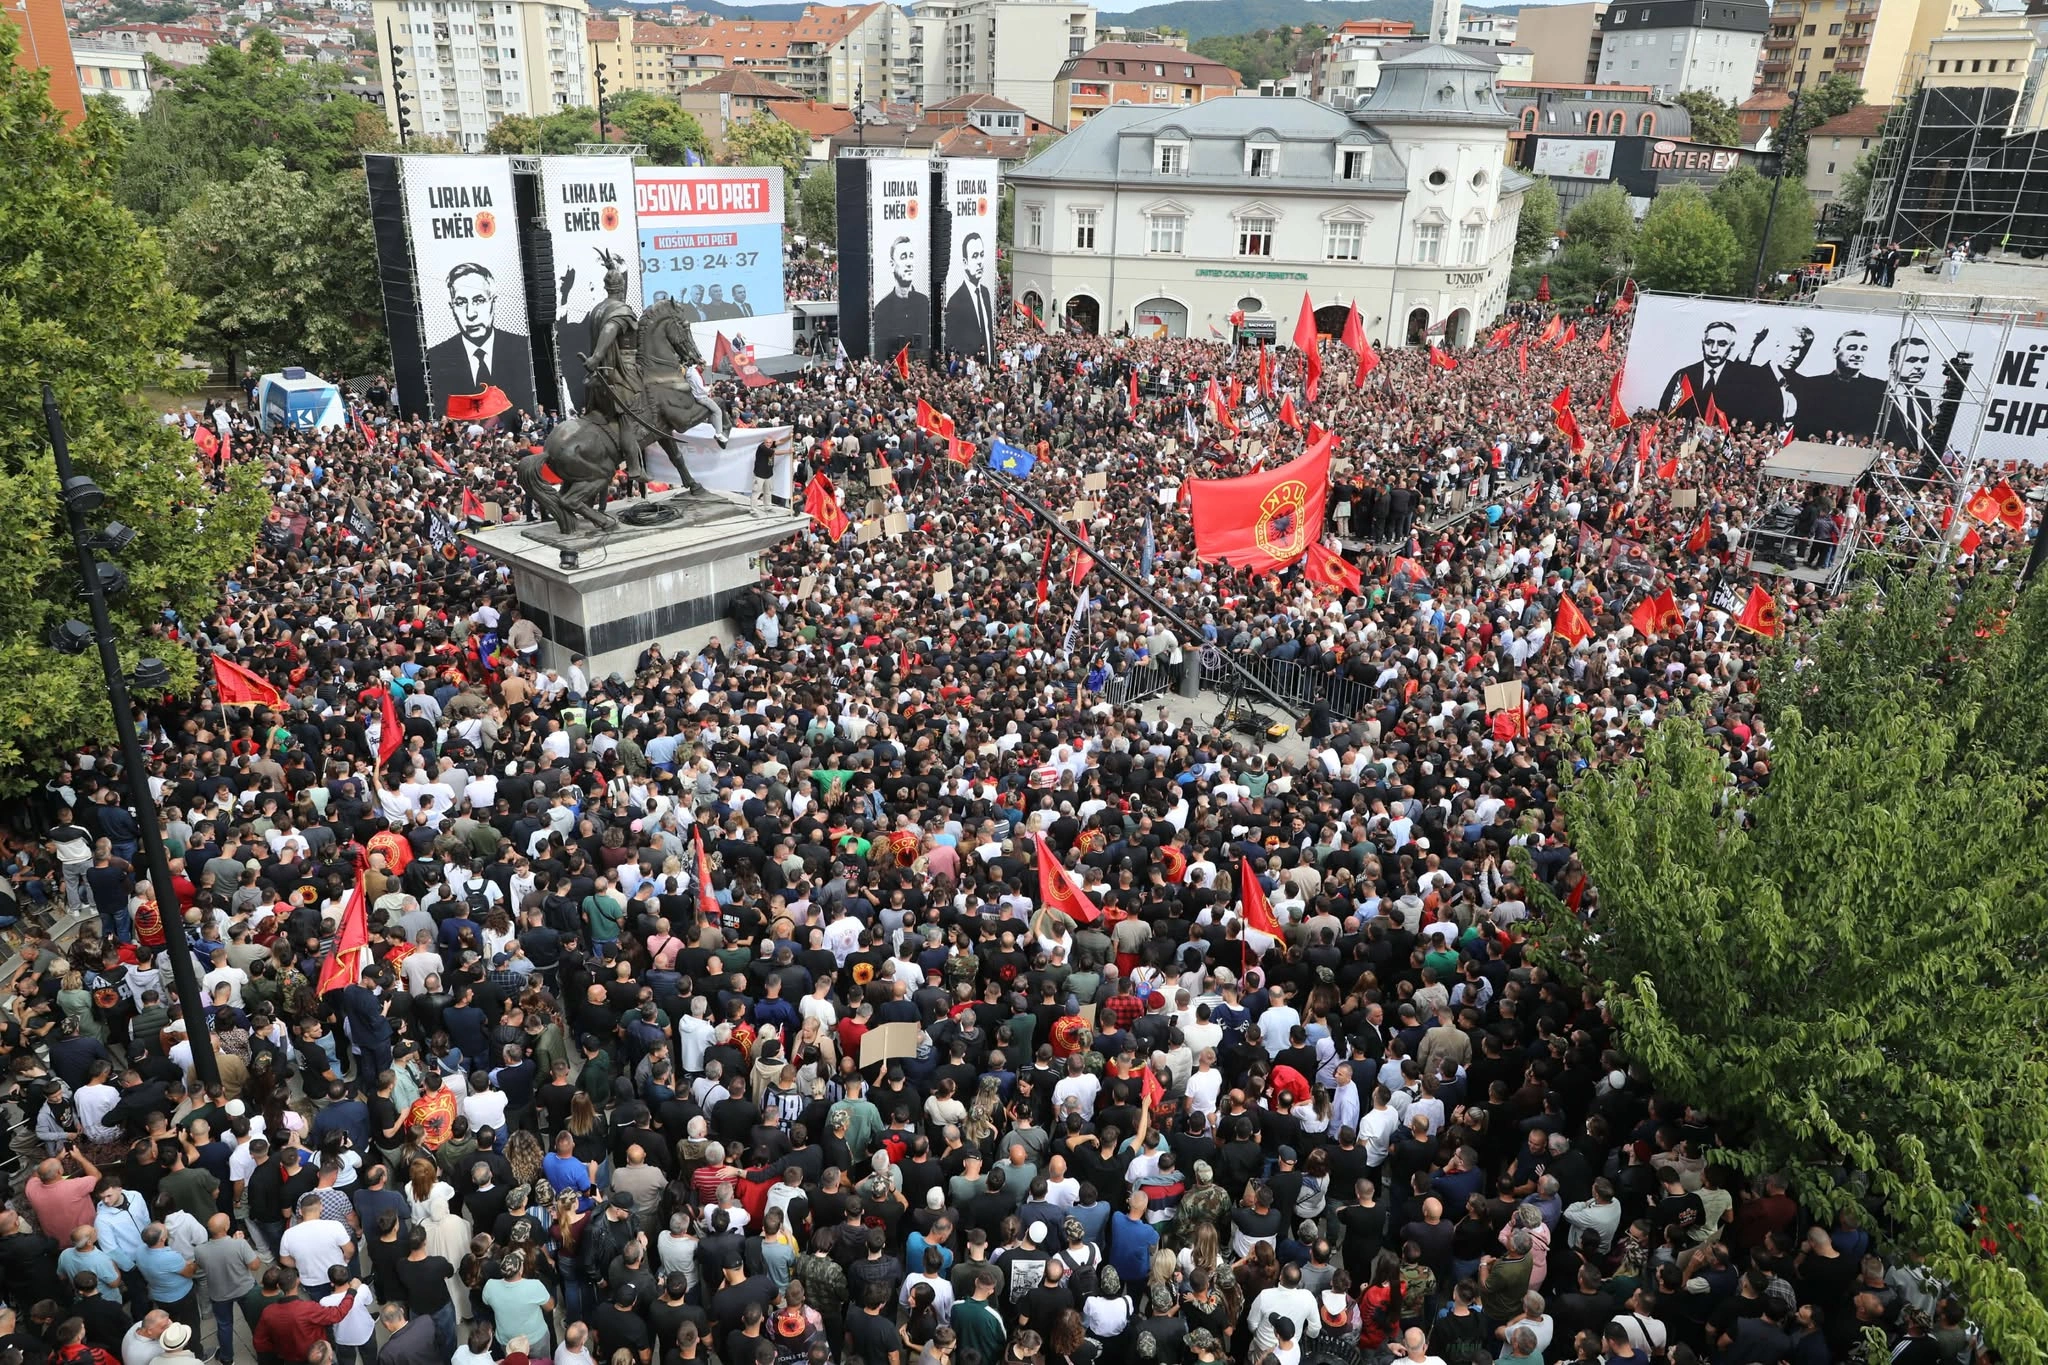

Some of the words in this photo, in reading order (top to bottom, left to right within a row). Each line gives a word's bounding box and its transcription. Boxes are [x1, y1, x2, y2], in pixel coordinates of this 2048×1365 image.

[1651, 151, 1740, 170] INTEREX
[428, 186, 470, 208] LIRIA
[472, 186, 493, 207] KA
[562, 183, 597, 204] LIRIA
[599, 182, 617, 202] KA
[884, 181, 906, 197] LIRIA
[907, 180, 918, 196] KA
[957, 180, 976, 195] LIRIA
[978, 180, 987, 194] KA
[636, 184, 692, 212] OSOVA
[696, 184, 719, 210] PO
[722, 183, 760, 210] PRET
[957, 198, 976, 216] EMËR
[565, 207, 600, 232] EMËR
[884, 200, 906, 220] EMËR
[432, 213, 474, 239] EMËR
[658, 236, 694, 248] KOSOVA
[697, 235, 709, 246] PO
[712, 234, 733, 246] PRET
[1195, 269, 1222, 277] UNITED
[1224, 270, 1254, 278] COLORS
[1255, 271, 1266, 279] OF
[1266, 272, 1308, 280] BENETTON
[1445, 272, 1484, 285] UNION
[1996, 344, 2048, 388] NË
